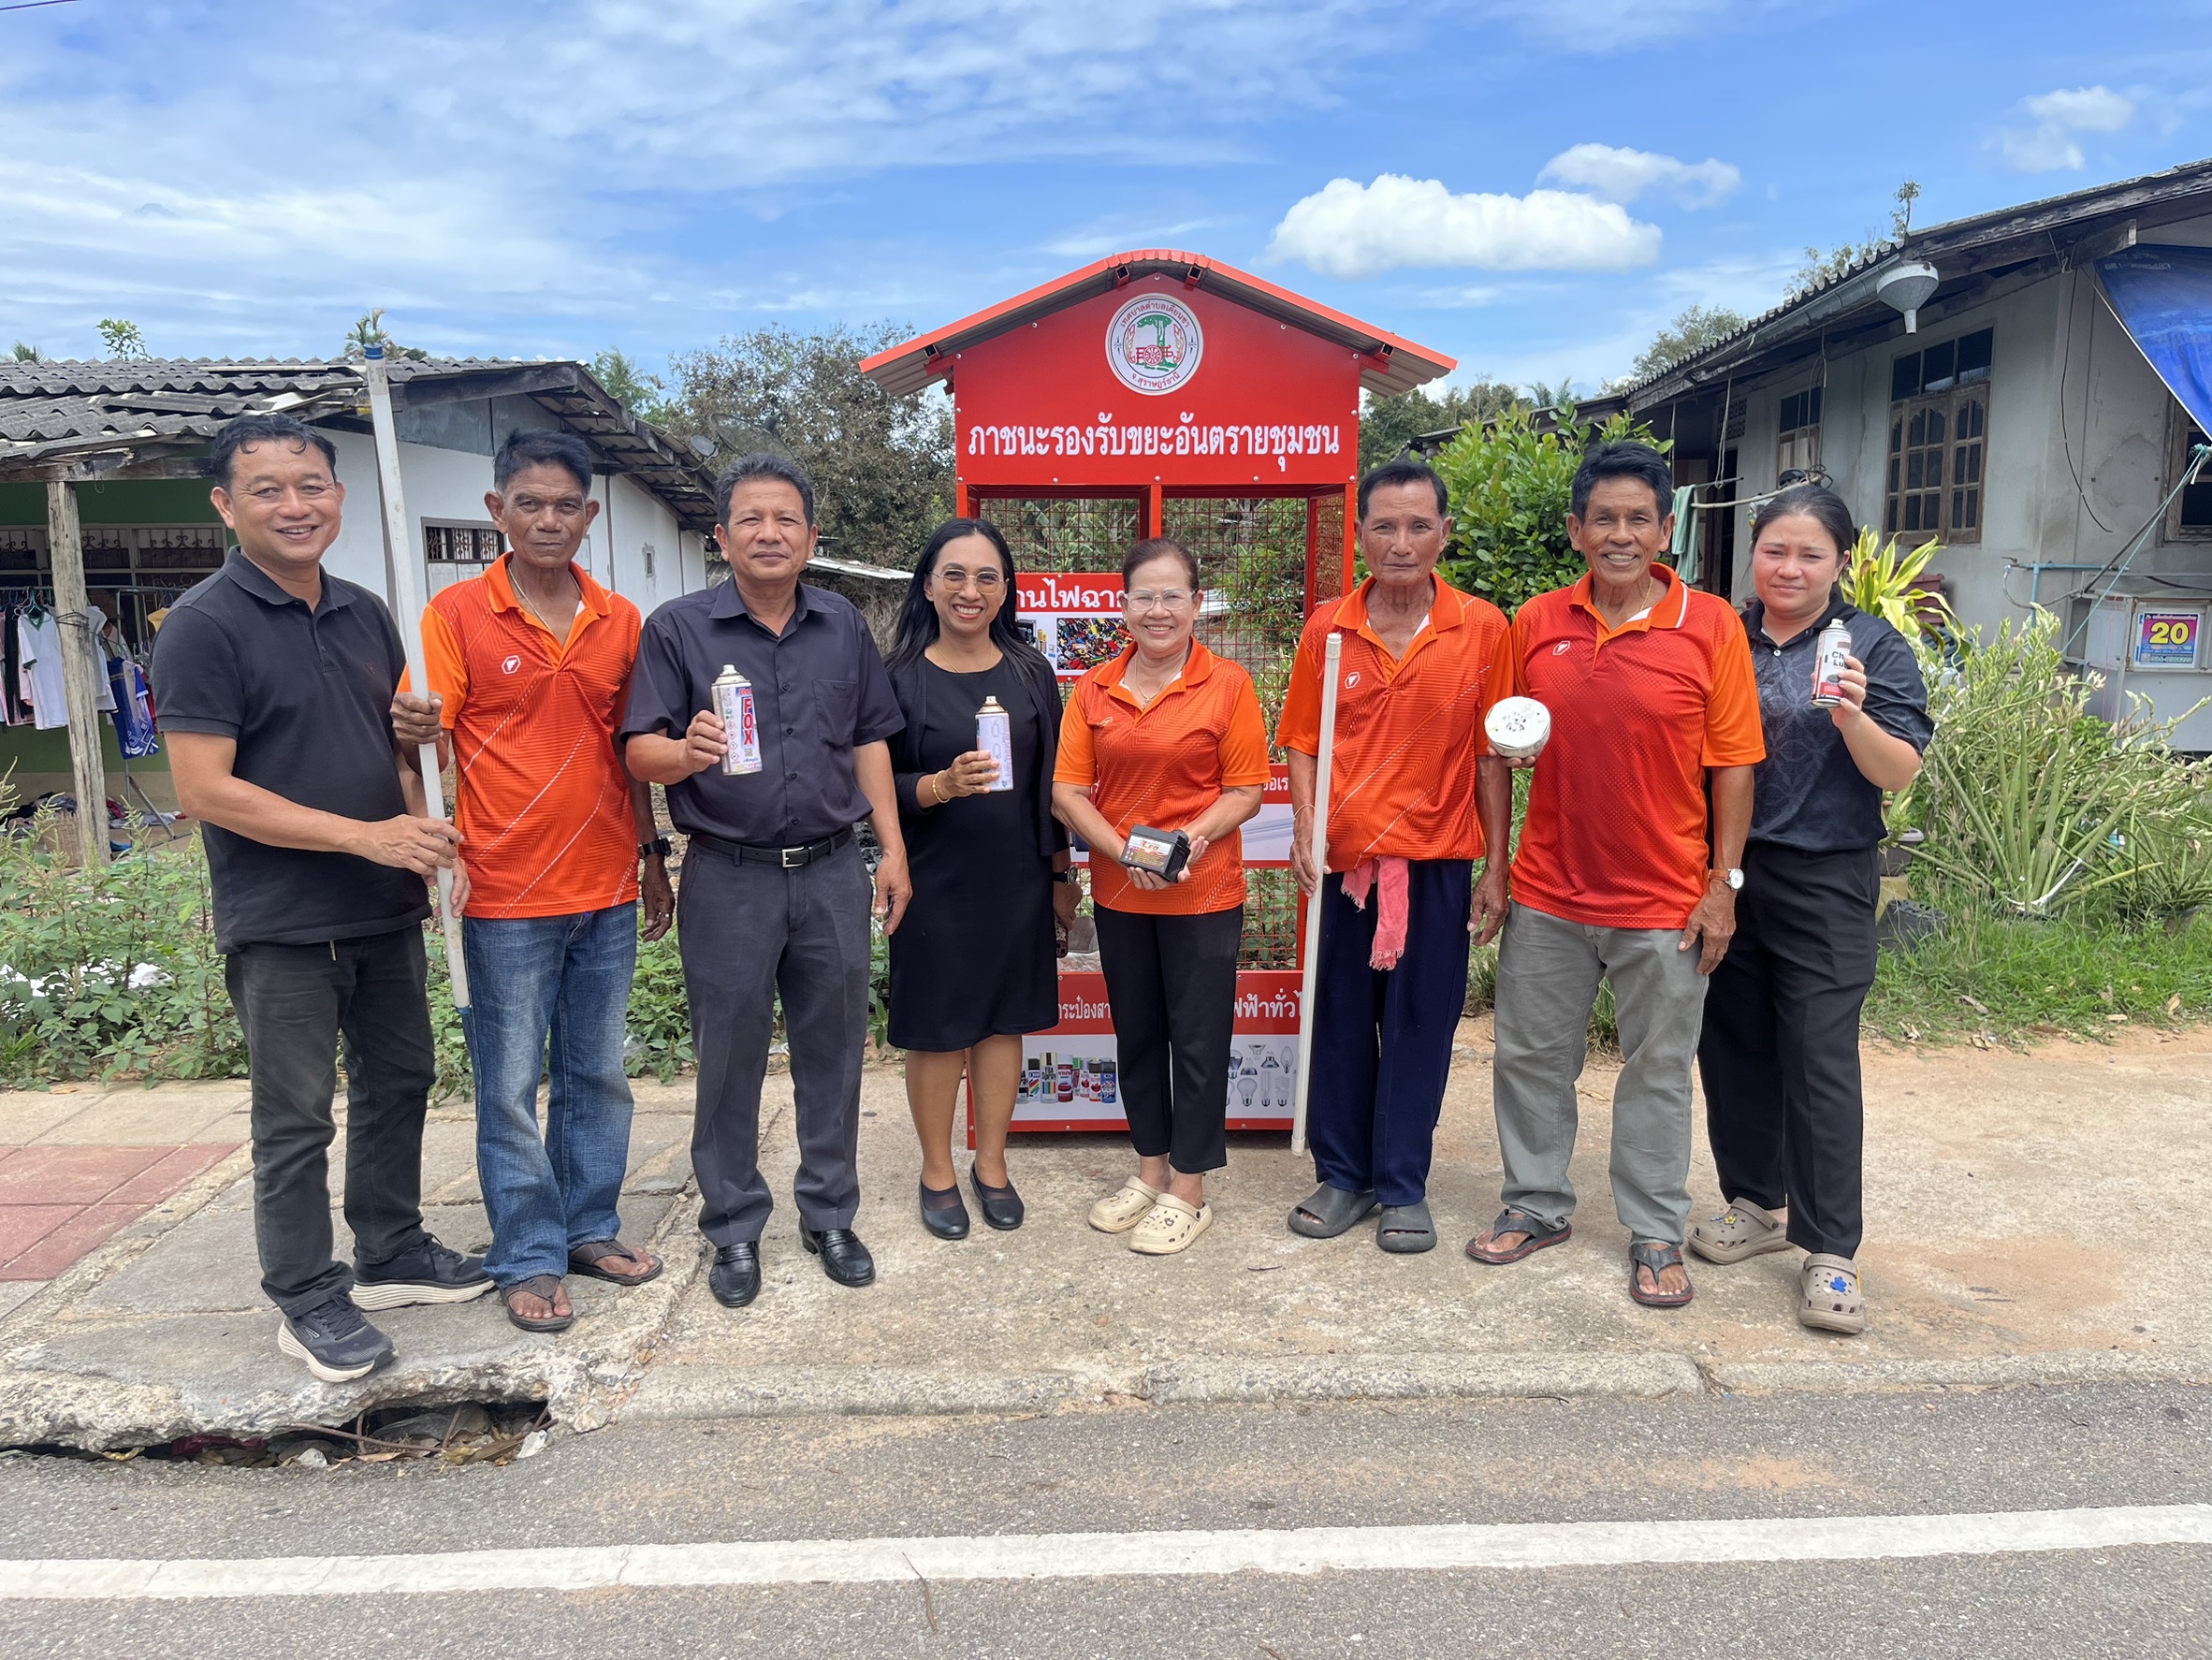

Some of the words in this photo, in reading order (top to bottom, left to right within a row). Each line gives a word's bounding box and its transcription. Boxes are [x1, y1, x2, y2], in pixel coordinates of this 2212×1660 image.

[968, 412, 1340, 473] ภาชนะรองรับขยะอันตรายชุมชน
[2148, 620, 2190, 645] 20
[742, 696, 755, 747] FOX
